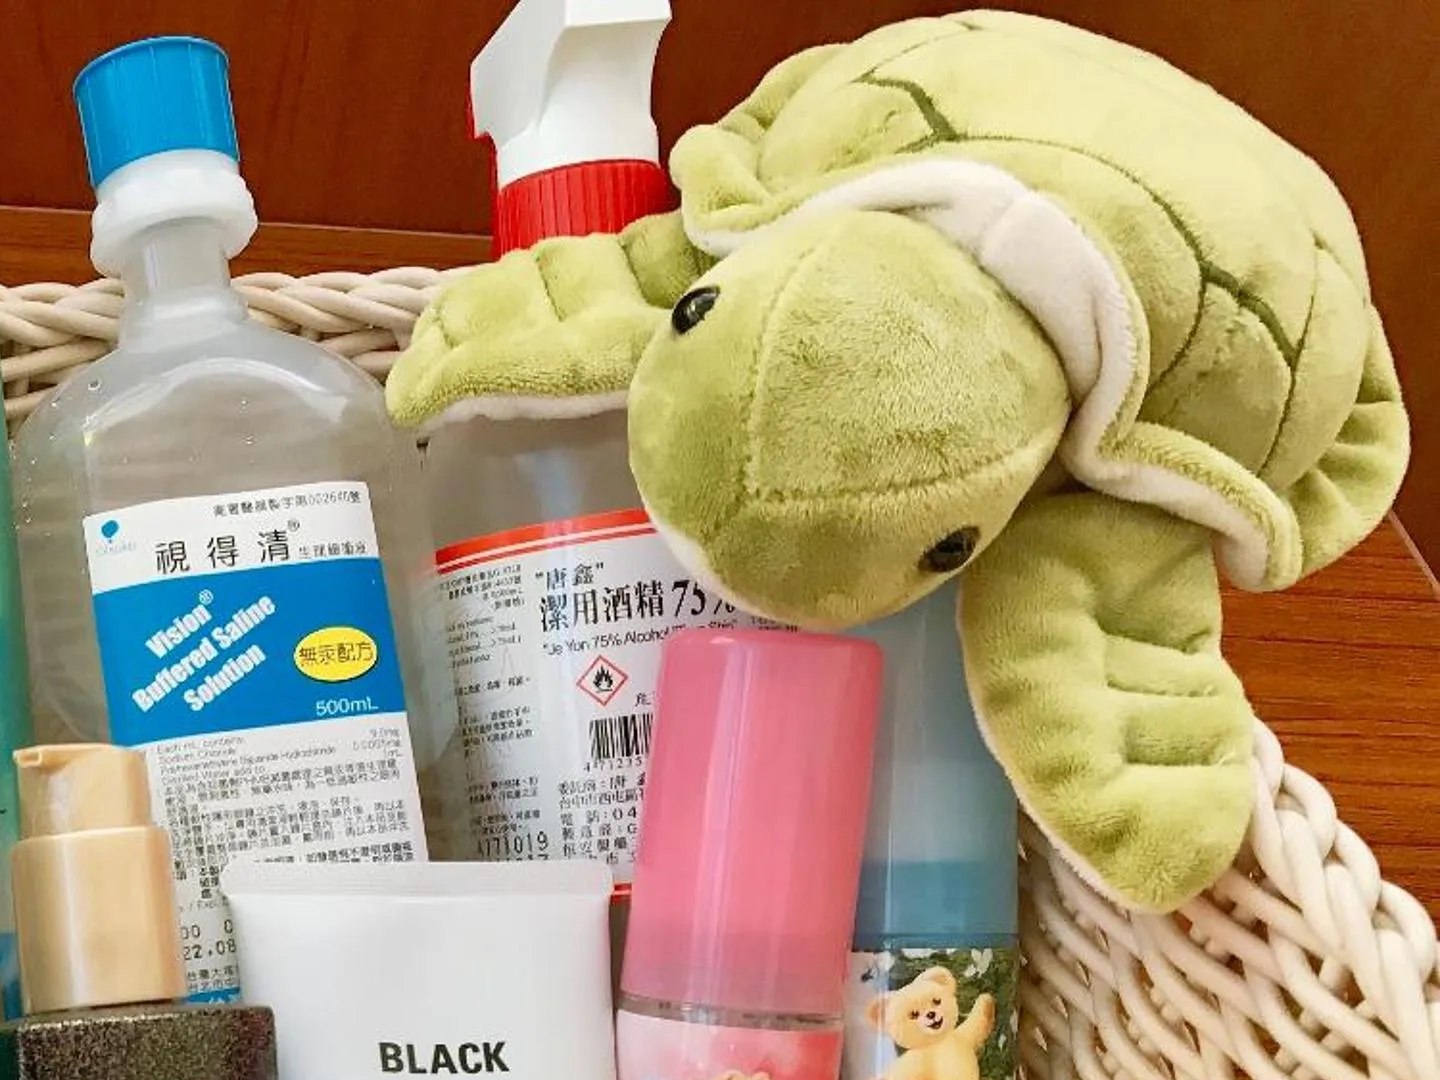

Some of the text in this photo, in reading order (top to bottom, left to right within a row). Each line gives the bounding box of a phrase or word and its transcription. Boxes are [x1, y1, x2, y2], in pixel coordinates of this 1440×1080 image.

[155, 529, 291, 575] 視得清
[132, 595, 276, 713] Buffered Saline
[145, 602, 213, 659] Vision
[183, 644, 267, 713] Solution
[315, 695, 379, 716] 500mL
[379, 1041, 510, 1075] BLACK
